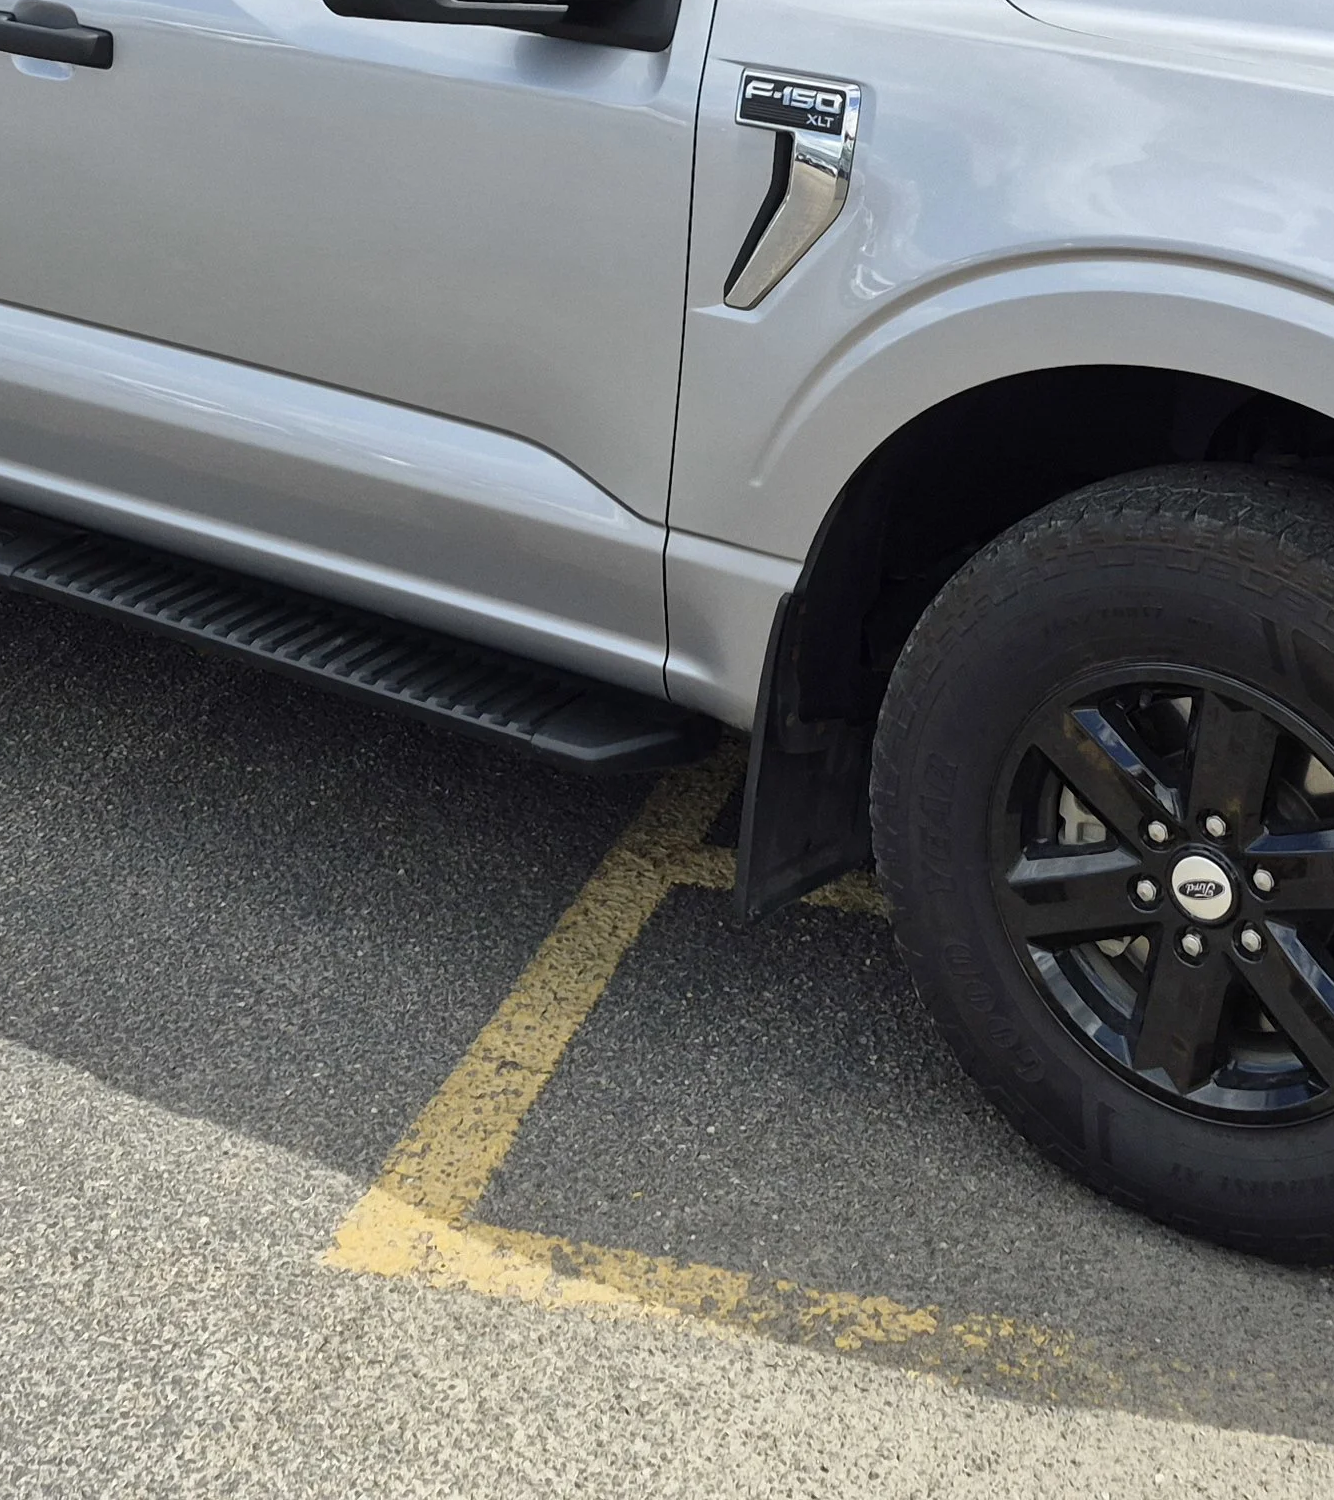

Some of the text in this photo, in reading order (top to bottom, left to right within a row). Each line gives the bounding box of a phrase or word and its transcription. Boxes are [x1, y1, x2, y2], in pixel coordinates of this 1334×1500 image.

[745, 80, 843, 114] F-150
[806, 113, 834, 128] XLT
[1185, 882, 1216, 897] Ford
